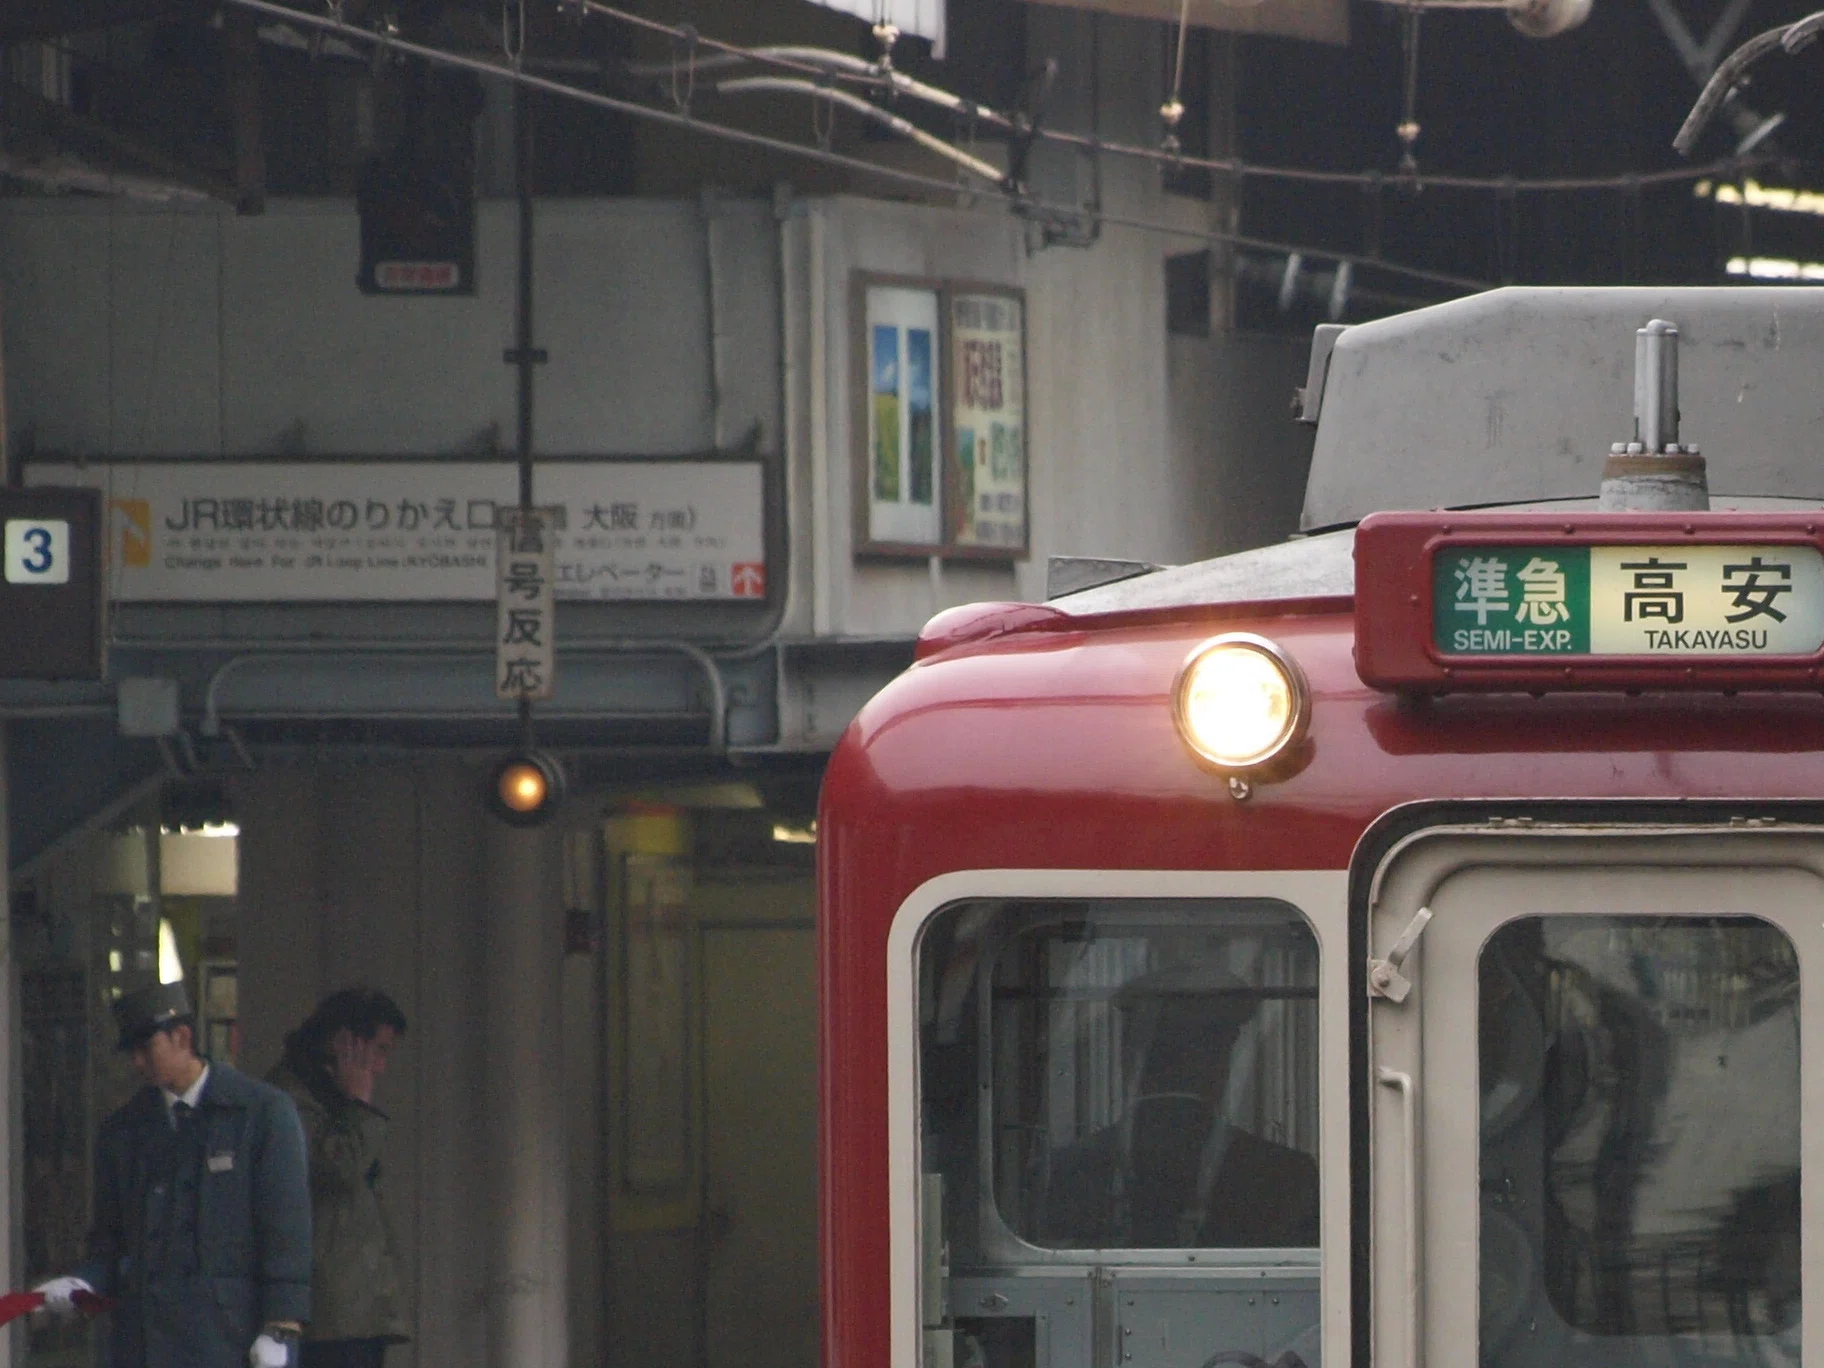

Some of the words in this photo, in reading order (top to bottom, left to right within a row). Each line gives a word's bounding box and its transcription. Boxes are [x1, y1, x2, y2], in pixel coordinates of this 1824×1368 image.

[22, 527, 53, 574] 3
[500, 507, 546, 692] 信号反応
[1454, 557, 1571, 626] 準急
[1619, 556, 1794, 625] 高安
[1453, 629, 1572, 651] SEMI-EXP.
[1644, 629, 1768, 650] TAKAYASU
